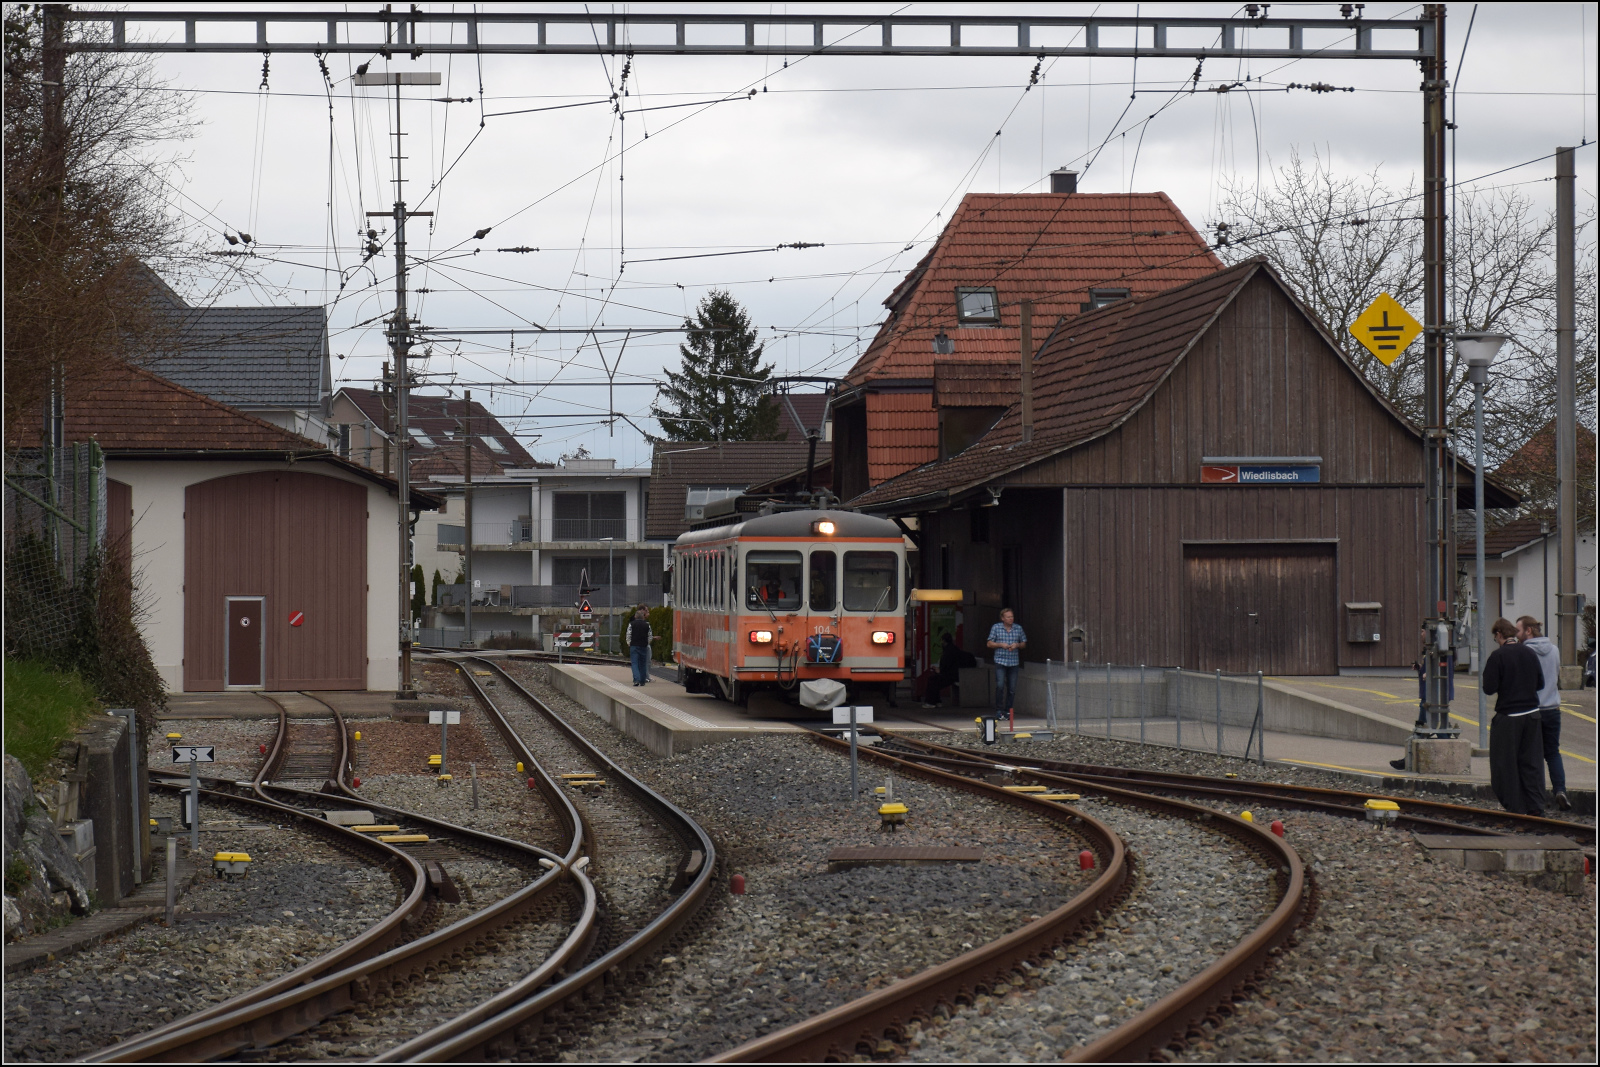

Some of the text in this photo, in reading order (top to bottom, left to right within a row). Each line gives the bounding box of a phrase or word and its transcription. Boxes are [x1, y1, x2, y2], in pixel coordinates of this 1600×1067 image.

[1241, 471, 1299, 480] Wiedlisbach
[813, 625, 831, 635] 104
[189, 748, 198, 761] S
